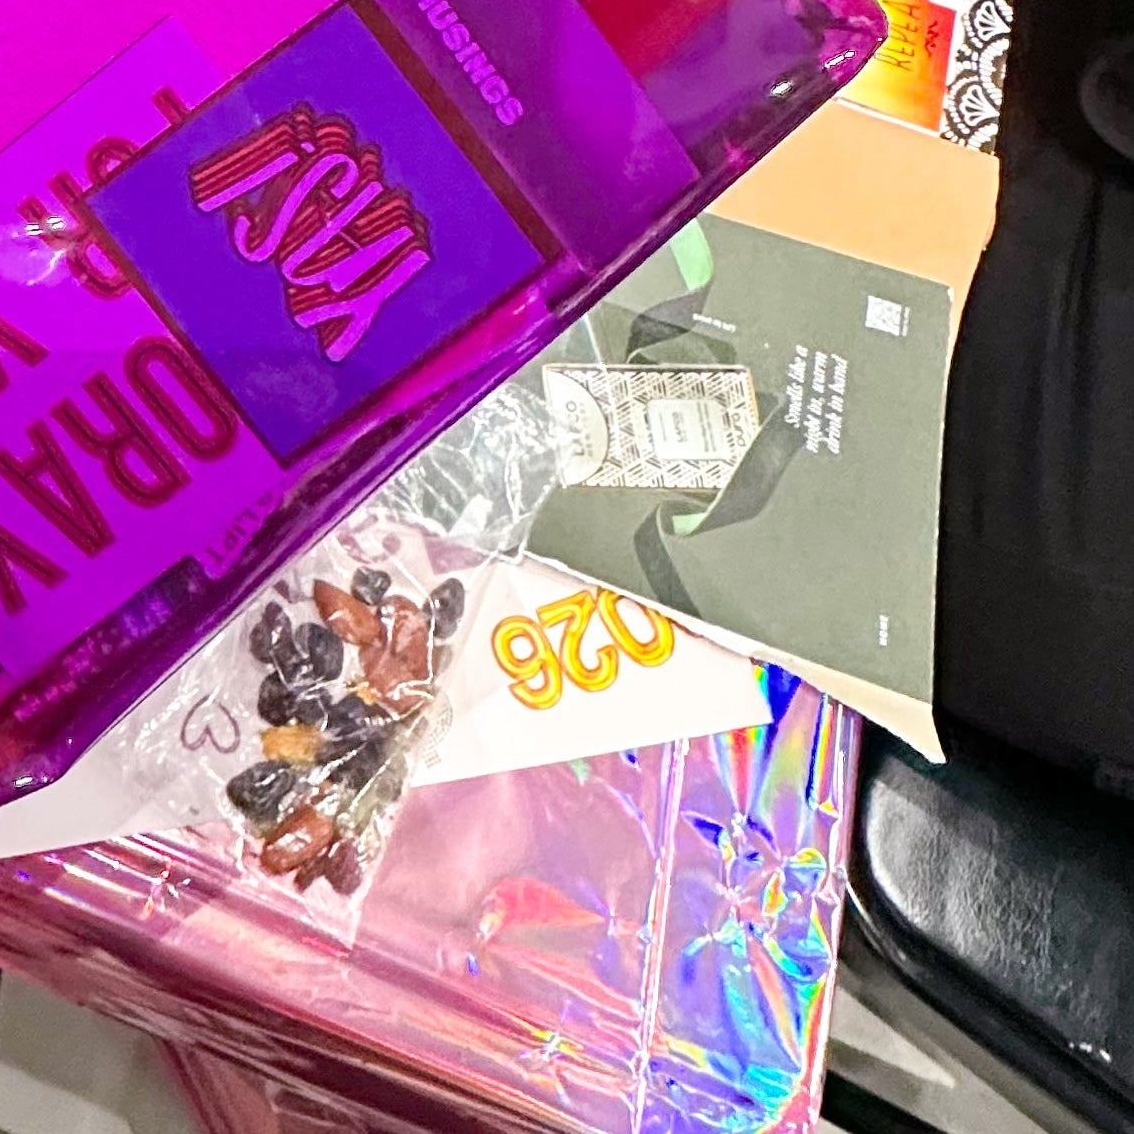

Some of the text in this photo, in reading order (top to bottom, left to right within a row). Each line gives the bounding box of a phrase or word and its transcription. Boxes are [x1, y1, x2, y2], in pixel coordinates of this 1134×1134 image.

[190, 100, 434, 364] YAS!
[783, 344, 809, 429] Smells like a
[803, 351, 828, 453] night in, warm
[823, 353, 849, 455] drink in hand
